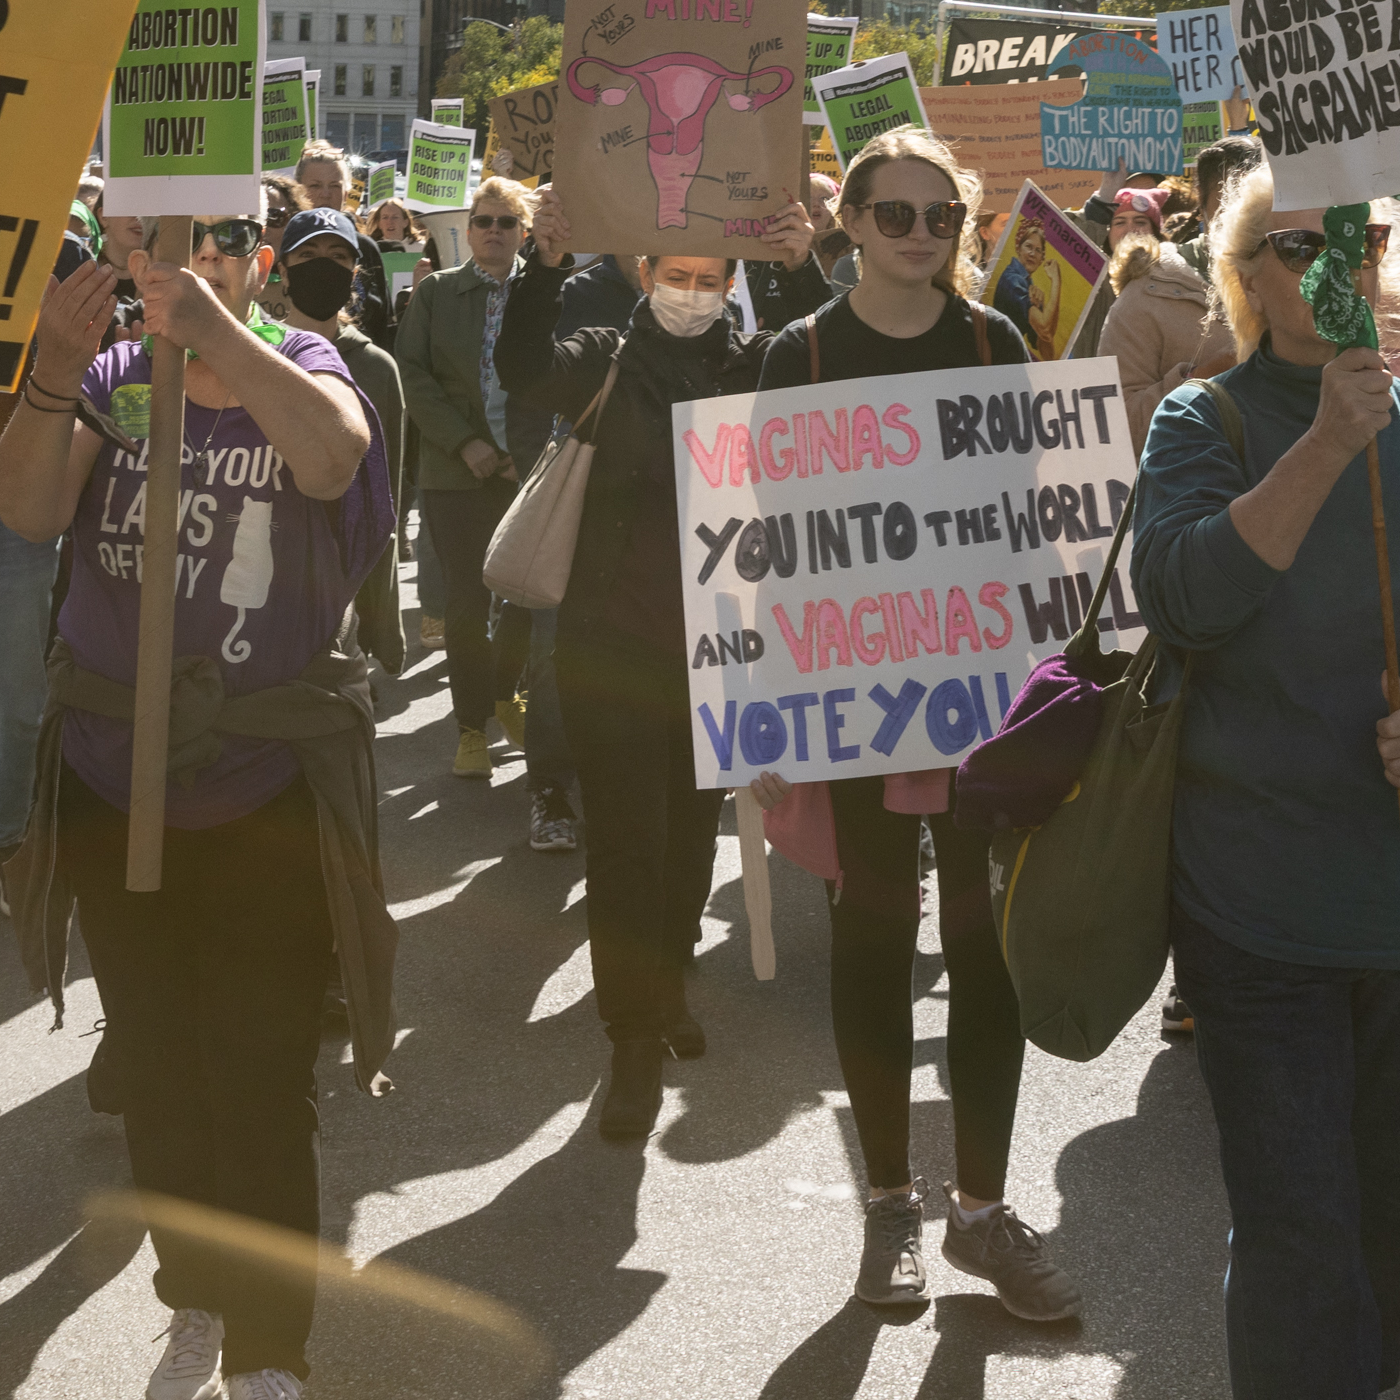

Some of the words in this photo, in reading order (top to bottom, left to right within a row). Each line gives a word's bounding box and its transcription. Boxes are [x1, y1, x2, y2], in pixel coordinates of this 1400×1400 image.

[128, 6, 240, 52] ABORTION
[590, 3, 616, 30] NOT
[597, 13, 636, 46] YOURS
[748, 37, 784, 60] MINE
[1169, 13, 1223, 54] HER
[814, 42, 833, 59] UP
[835, 43, 847, 60] 4
[1069, 34, 1149, 65] ABORTION
[1238, 25, 1336, 92] WOULD
[1334, 9, 1385, 61] BE
[114, 60, 254, 105] NATIONWIDE
[1172, 54, 1223, 93] HER
[262, 89, 288, 106] EGAL
[504, 86, 558, 132] RO
[849, 93, 894, 120] LEGAL
[262, 105, 299, 125] ORTION
[1043, 106, 1093, 135] THE
[1098, 106, 1153, 136] RIGHT
[1151, 107, 1178, 135] TO
[143, 116, 207, 158] NOW!
[600, 125, 634, 155] MINE
[263, 146, 291, 164] NOW!
[414, 145, 437, 162] RISE
[440, 151, 456, 164] UP
[458, 152, 467, 165] 4
[412, 162, 465, 182] ABORTION
[726, 171, 751, 184] NOT
[416, 181, 457, 199] RIGHTS!
[726, 186, 769, 201] YOURS
[1025, 191, 1051, 220] WE
[723, 214, 778, 238] MIN
[681, 402, 921, 489] VAGINAS
[935, 383, 1119, 461] BROUGHT
[205, 444, 284, 492] YOUR
[694, 510, 798, 586] YOU
[805, 501, 919, 576] INTO
[923, 503, 1003, 548] THE
[1001, 478, 1135, 554] WORLD
[691, 628, 766, 670] AND
[771, 581, 1015, 675] VAGINAS
[697, 686, 861, 772] VOTE
